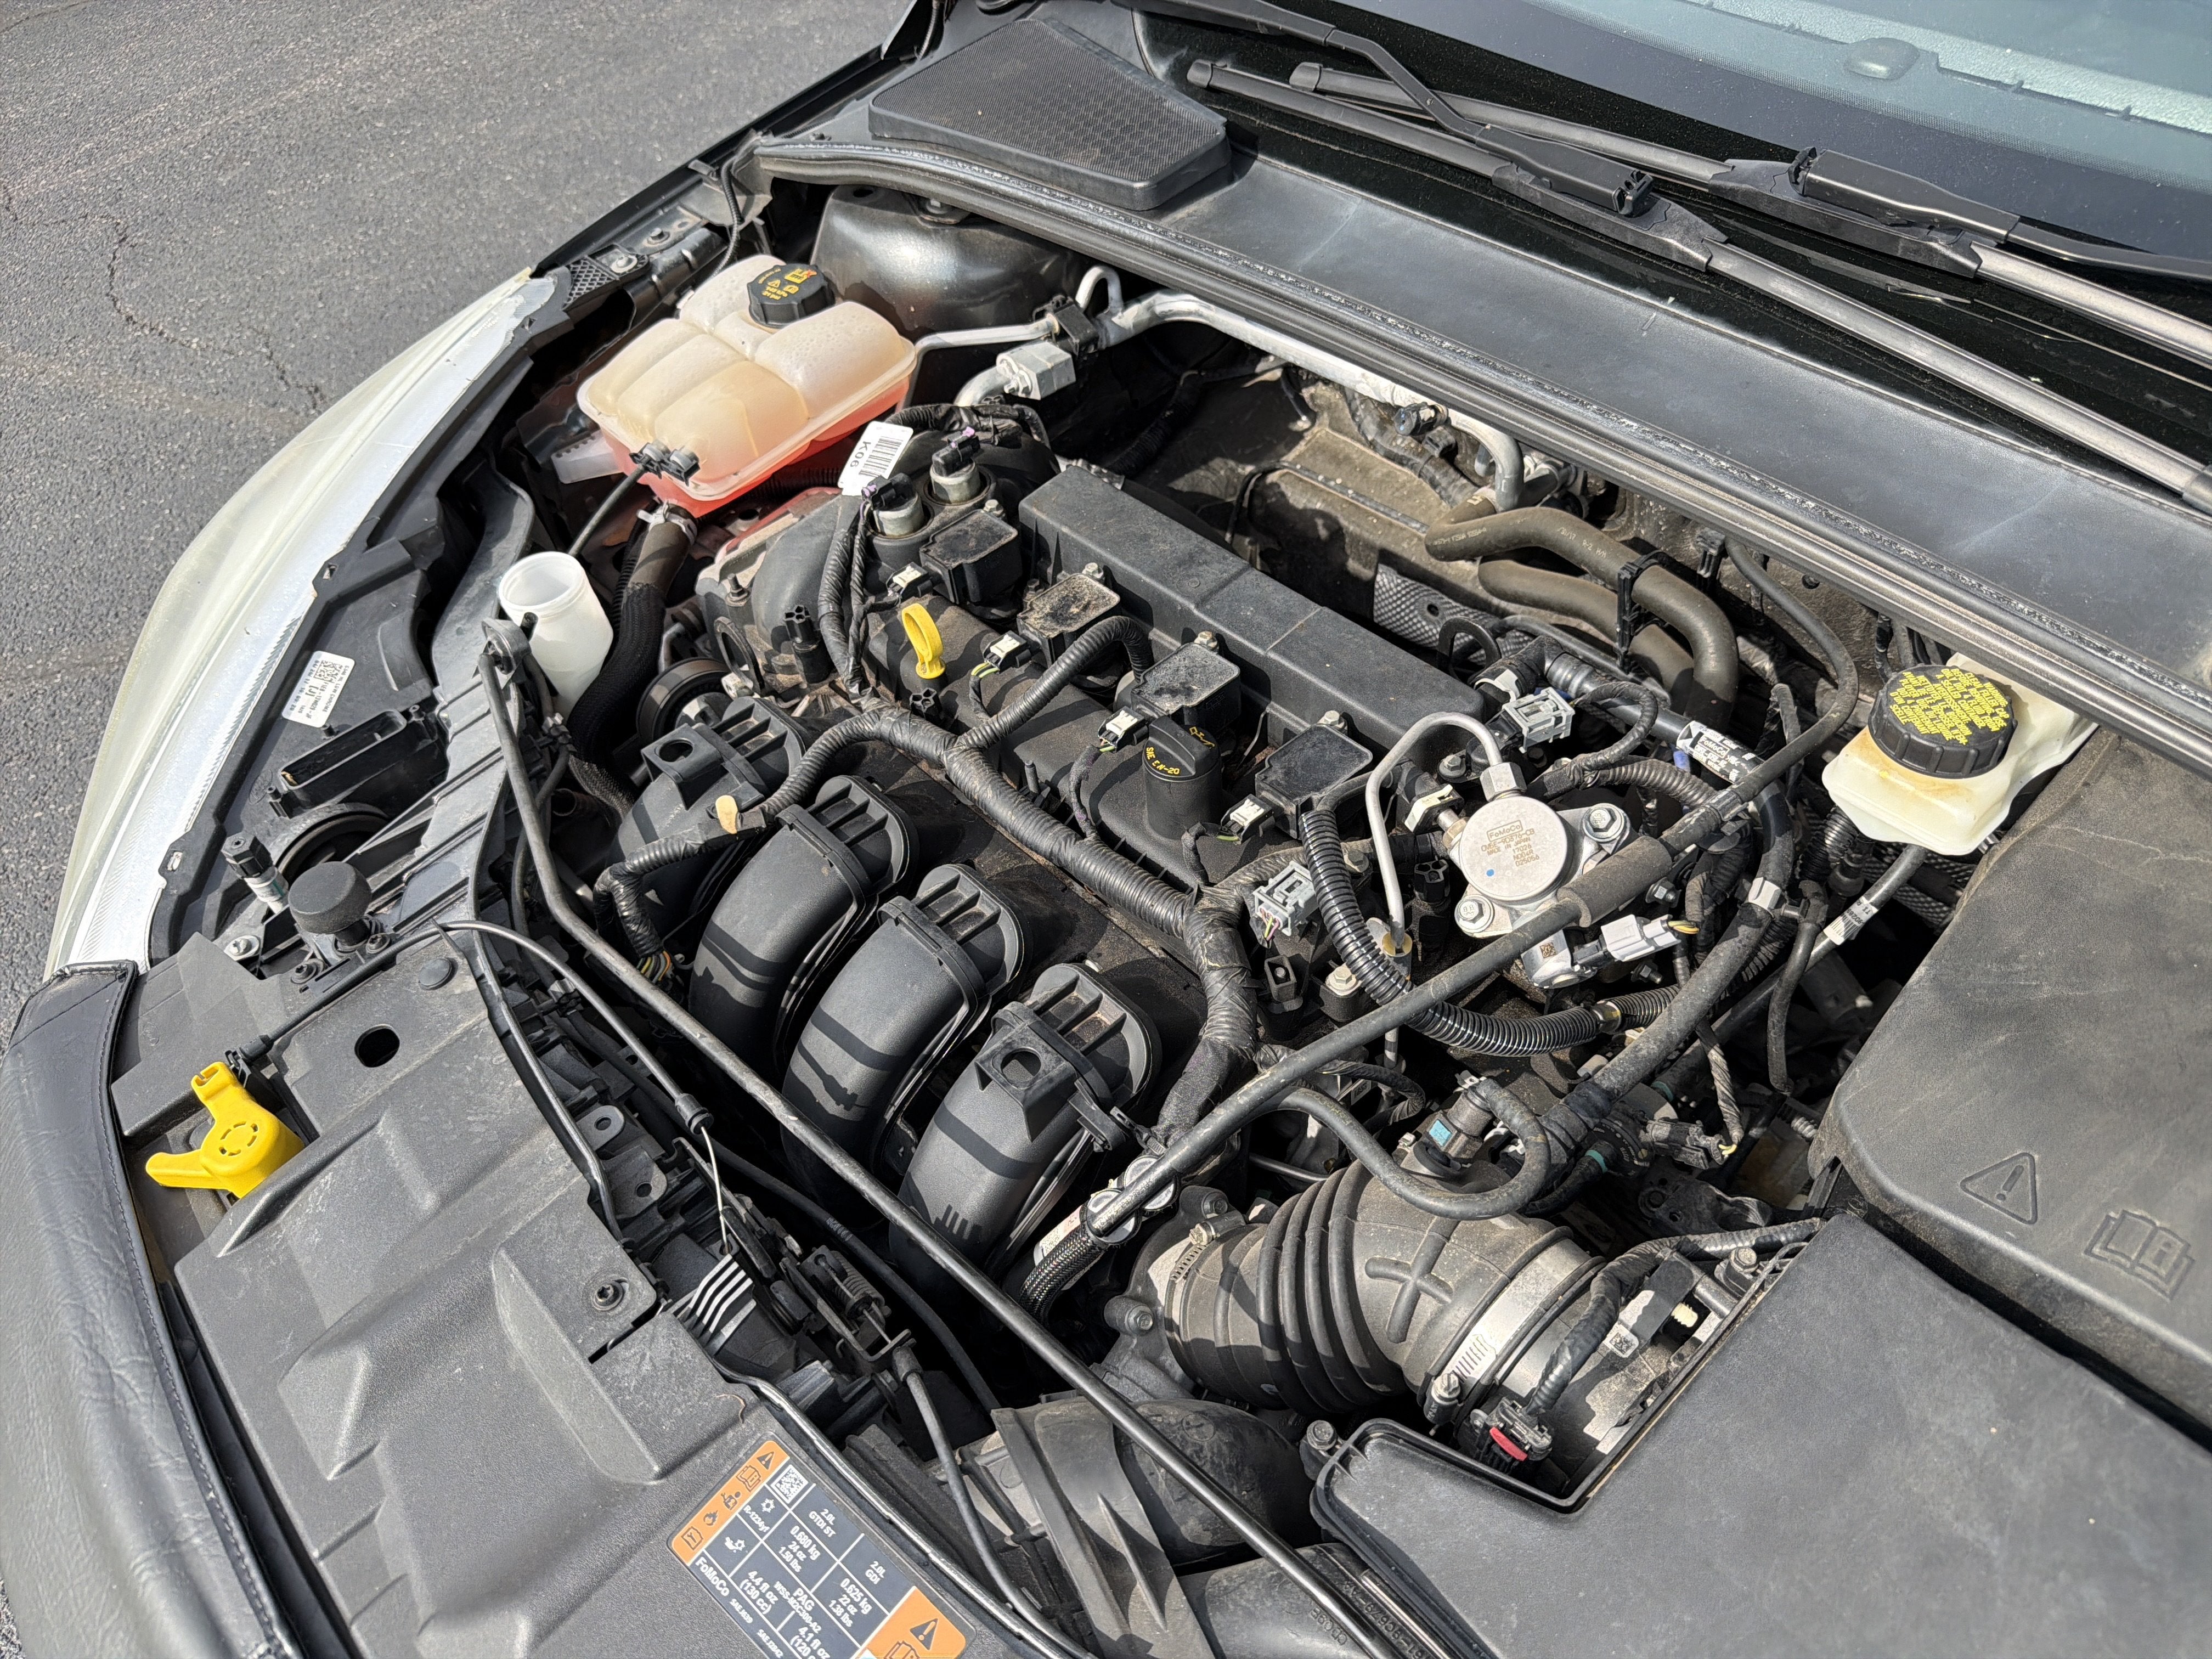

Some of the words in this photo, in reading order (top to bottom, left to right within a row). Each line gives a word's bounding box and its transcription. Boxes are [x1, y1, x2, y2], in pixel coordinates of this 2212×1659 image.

[850, 441, 871, 467] K06
[1903, 672, 1922, 687] AVANT
[1917, 688, 1929, 696] DE
[1941, 680, 1961, 698] SEALED
[1950, 668, 1973, 687] BEFORE
[1993, 716, 2007, 727] USE
[1965, 673, 1984, 689] CLEAN
[1979, 689, 1999, 707] FILLER
[1896, 687, 1911, 697] DOT
[1910, 704, 1940, 734] PROVENANT
[1899, 679, 1920, 698] PLOYER
[1916, 698, 1930, 710] QUE
[1925, 710, 1937, 719] DU
[1932, 720, 1955, 741] LIQUIDE
[1916, 675, 1942, 701] NETTOYER
[1946, 711, 1972, 736] BOUCHON
[1941, 669, 1957, 681] ONLY
[1953, 682, 1967, 692] DOT
[1967, 699, 1985, 714] FLUID
[1980, 715, 2000, 732] FROM
[1901, 705, 1930, 734] CONTENANT
[1146, 747, 1155, 760] SAE
[1489, 825, 1521, 839] FoMoCo
[1487, 847, 1501, 856] MADE
[1514, 837, 1530, 846] JAPAN
[1515, 854, 1539, 867] 025056
[743, 1505, 770, 1533] R-1234yf
[809, 1511, 825, 1529] GTDI
[824, 1527, 836, 1538] ST
[820, 1509, 836, 1526] 2.0L
[788, 1541, 799, 1553] 24
[797, 1550, 807, 1561] oz
[790, 1525, 814, 1551] 0.680
[809, 1544, 821, 1560] kg
[778, 1547, 792, 1562] 1.50
[789, 1559, 802, 1573] lbs
[870, 1561, 886, 1578] 2.0L
[695, 1557, 730, 1596] FoMoCo
[748, 1571, 764, 1585] 4.4
[759, 1581, 770, 1593] fl
[766, 1591, 778, 1605] oz
[865, 1569, 881, 1584] GDI
[740, 1579, 760, 1600] (130
[756, 1598, 772, 1615] cc)
[774, 1581, 822, 1634] WSS-M2C300-A2
[793, 1587, 815, 1611] PAG
[838, 1594, 851, 1607] 22
[847, 1603, 858, 1616] oz
[840, 1578, 864, 1604] 0.625
[860, 1597, 873, 1615] kg
[828, 1600, 844, 1616] 1.38
[840, 1612, 853, 1627] lbs
[790, 1635, 811, 1657] (120
[798, 1627, 815, 1642] 4.1
[810, 1639, 822, 1650] fl
[816, 1648, 831, 1659] oz
